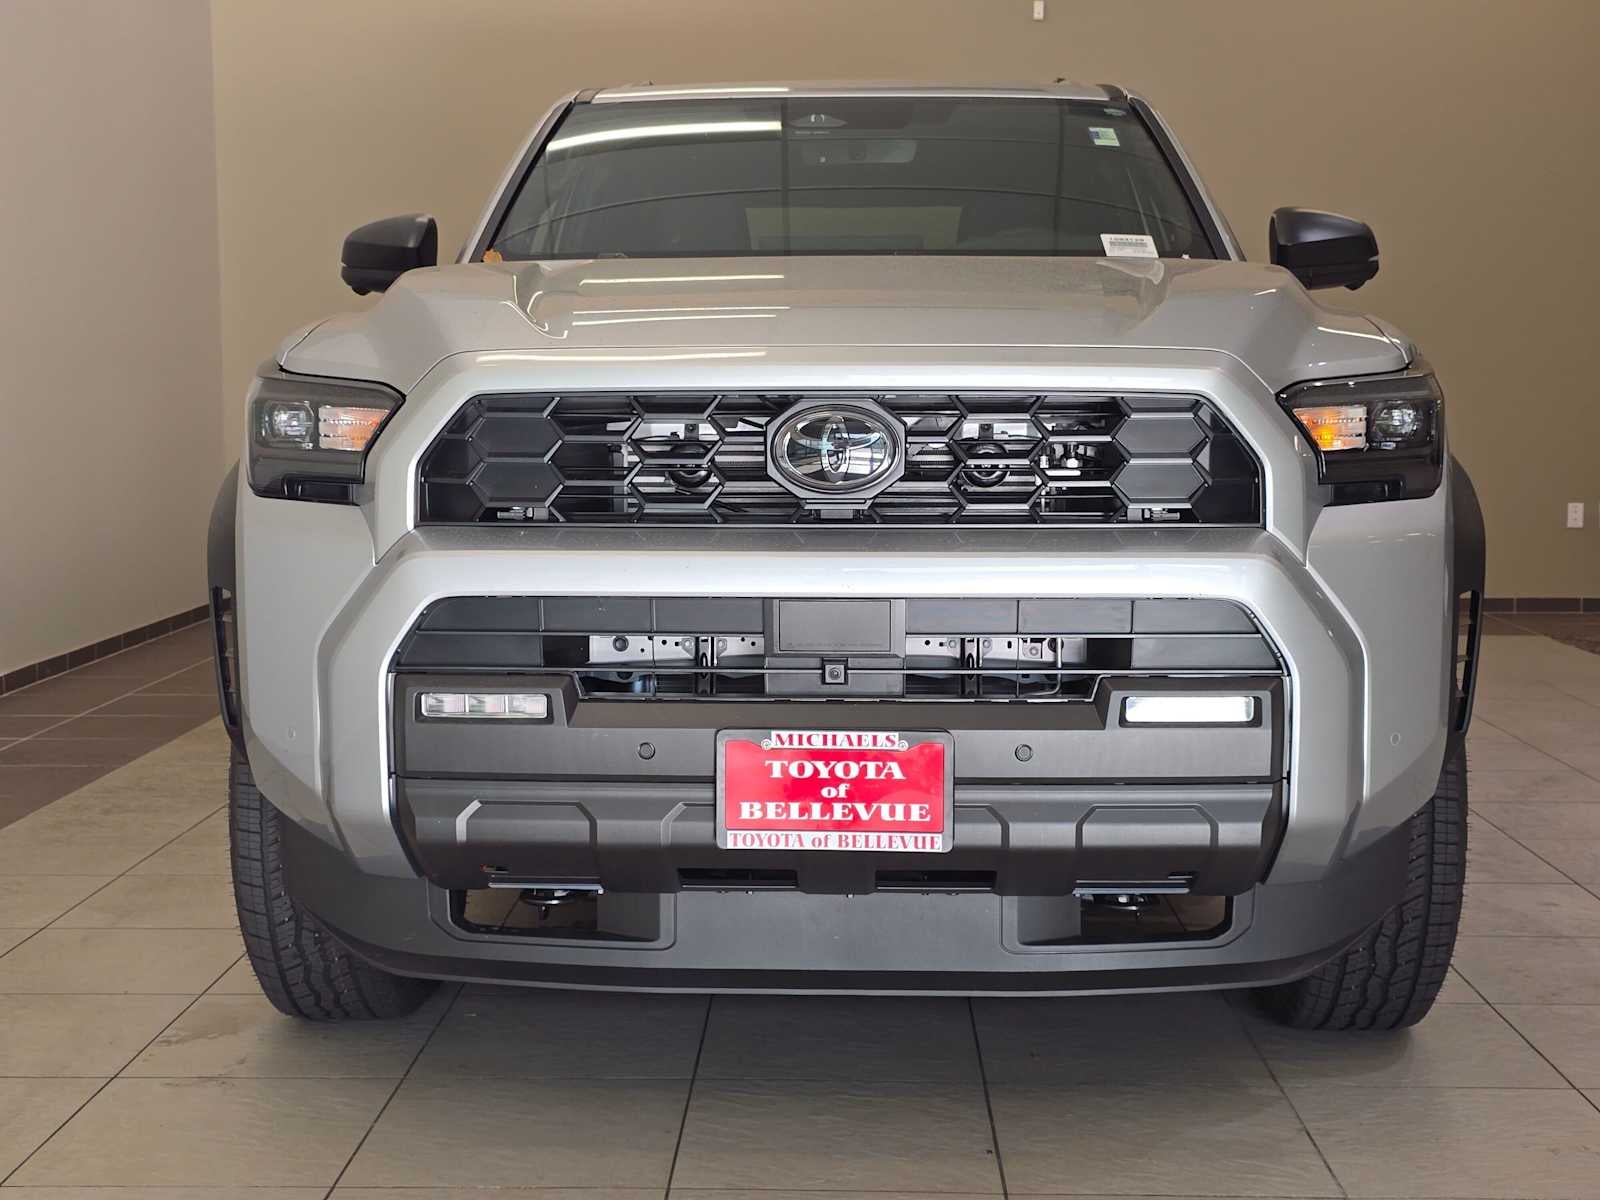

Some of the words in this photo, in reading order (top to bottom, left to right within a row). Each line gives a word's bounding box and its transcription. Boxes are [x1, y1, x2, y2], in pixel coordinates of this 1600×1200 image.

[775, 733, 897, 748] MICHAELS
[765, 760, 906, 780] TOYOTA
[820, 783, 850, 798] of
[739, 802, 931, 822] BELLEVUE
[729, 832, 805, 848] TOYOTA
[811, 833, 834, 848] of
[838, 833, 941, 850] BELLEVUE
